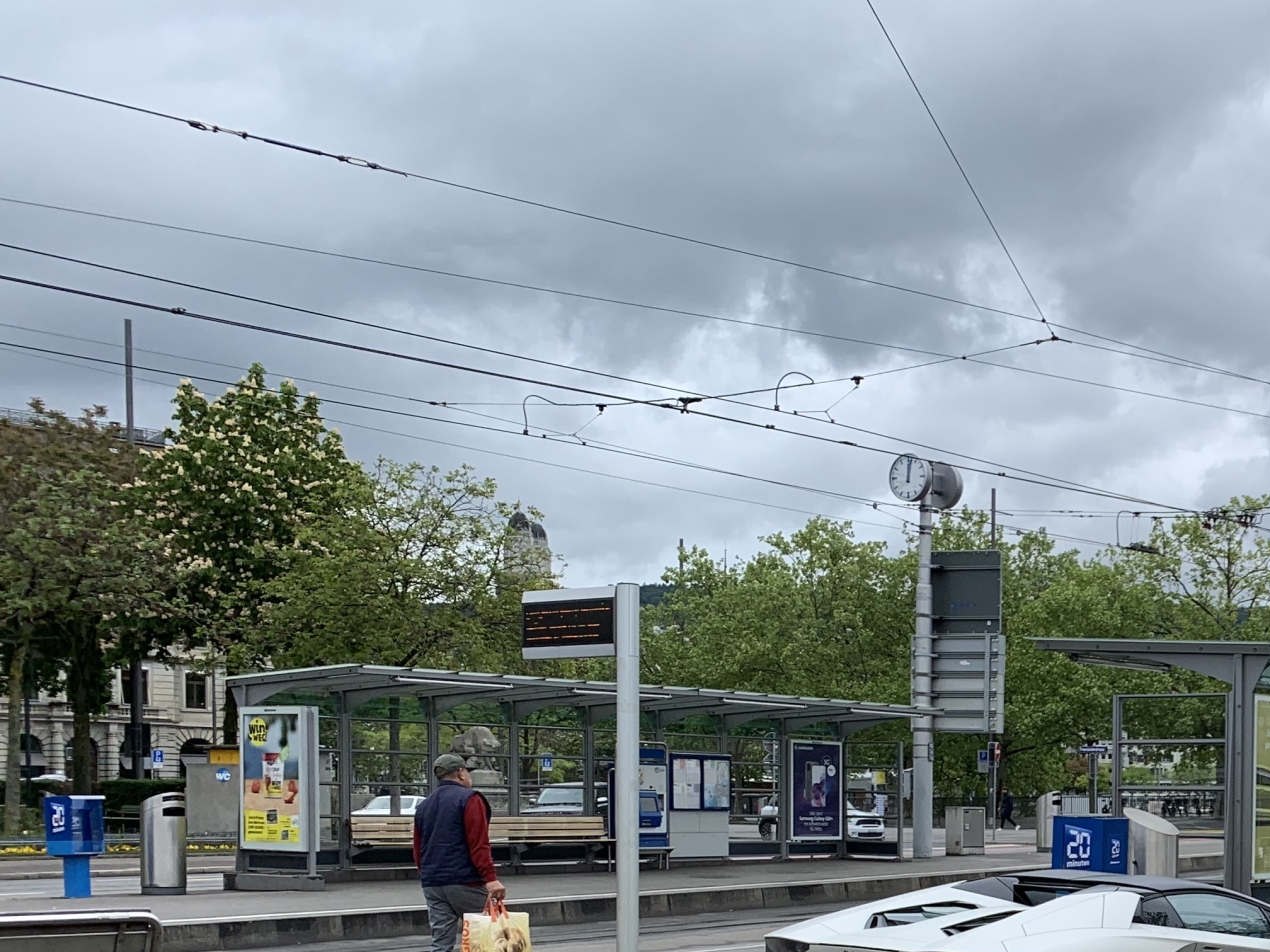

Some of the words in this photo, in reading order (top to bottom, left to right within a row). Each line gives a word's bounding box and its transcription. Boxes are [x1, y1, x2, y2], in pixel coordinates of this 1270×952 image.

[215, 772, 231, 781] WC
[1066, 829, 1091, 859] 20
[1066, 860, 1090, 868] minuten
